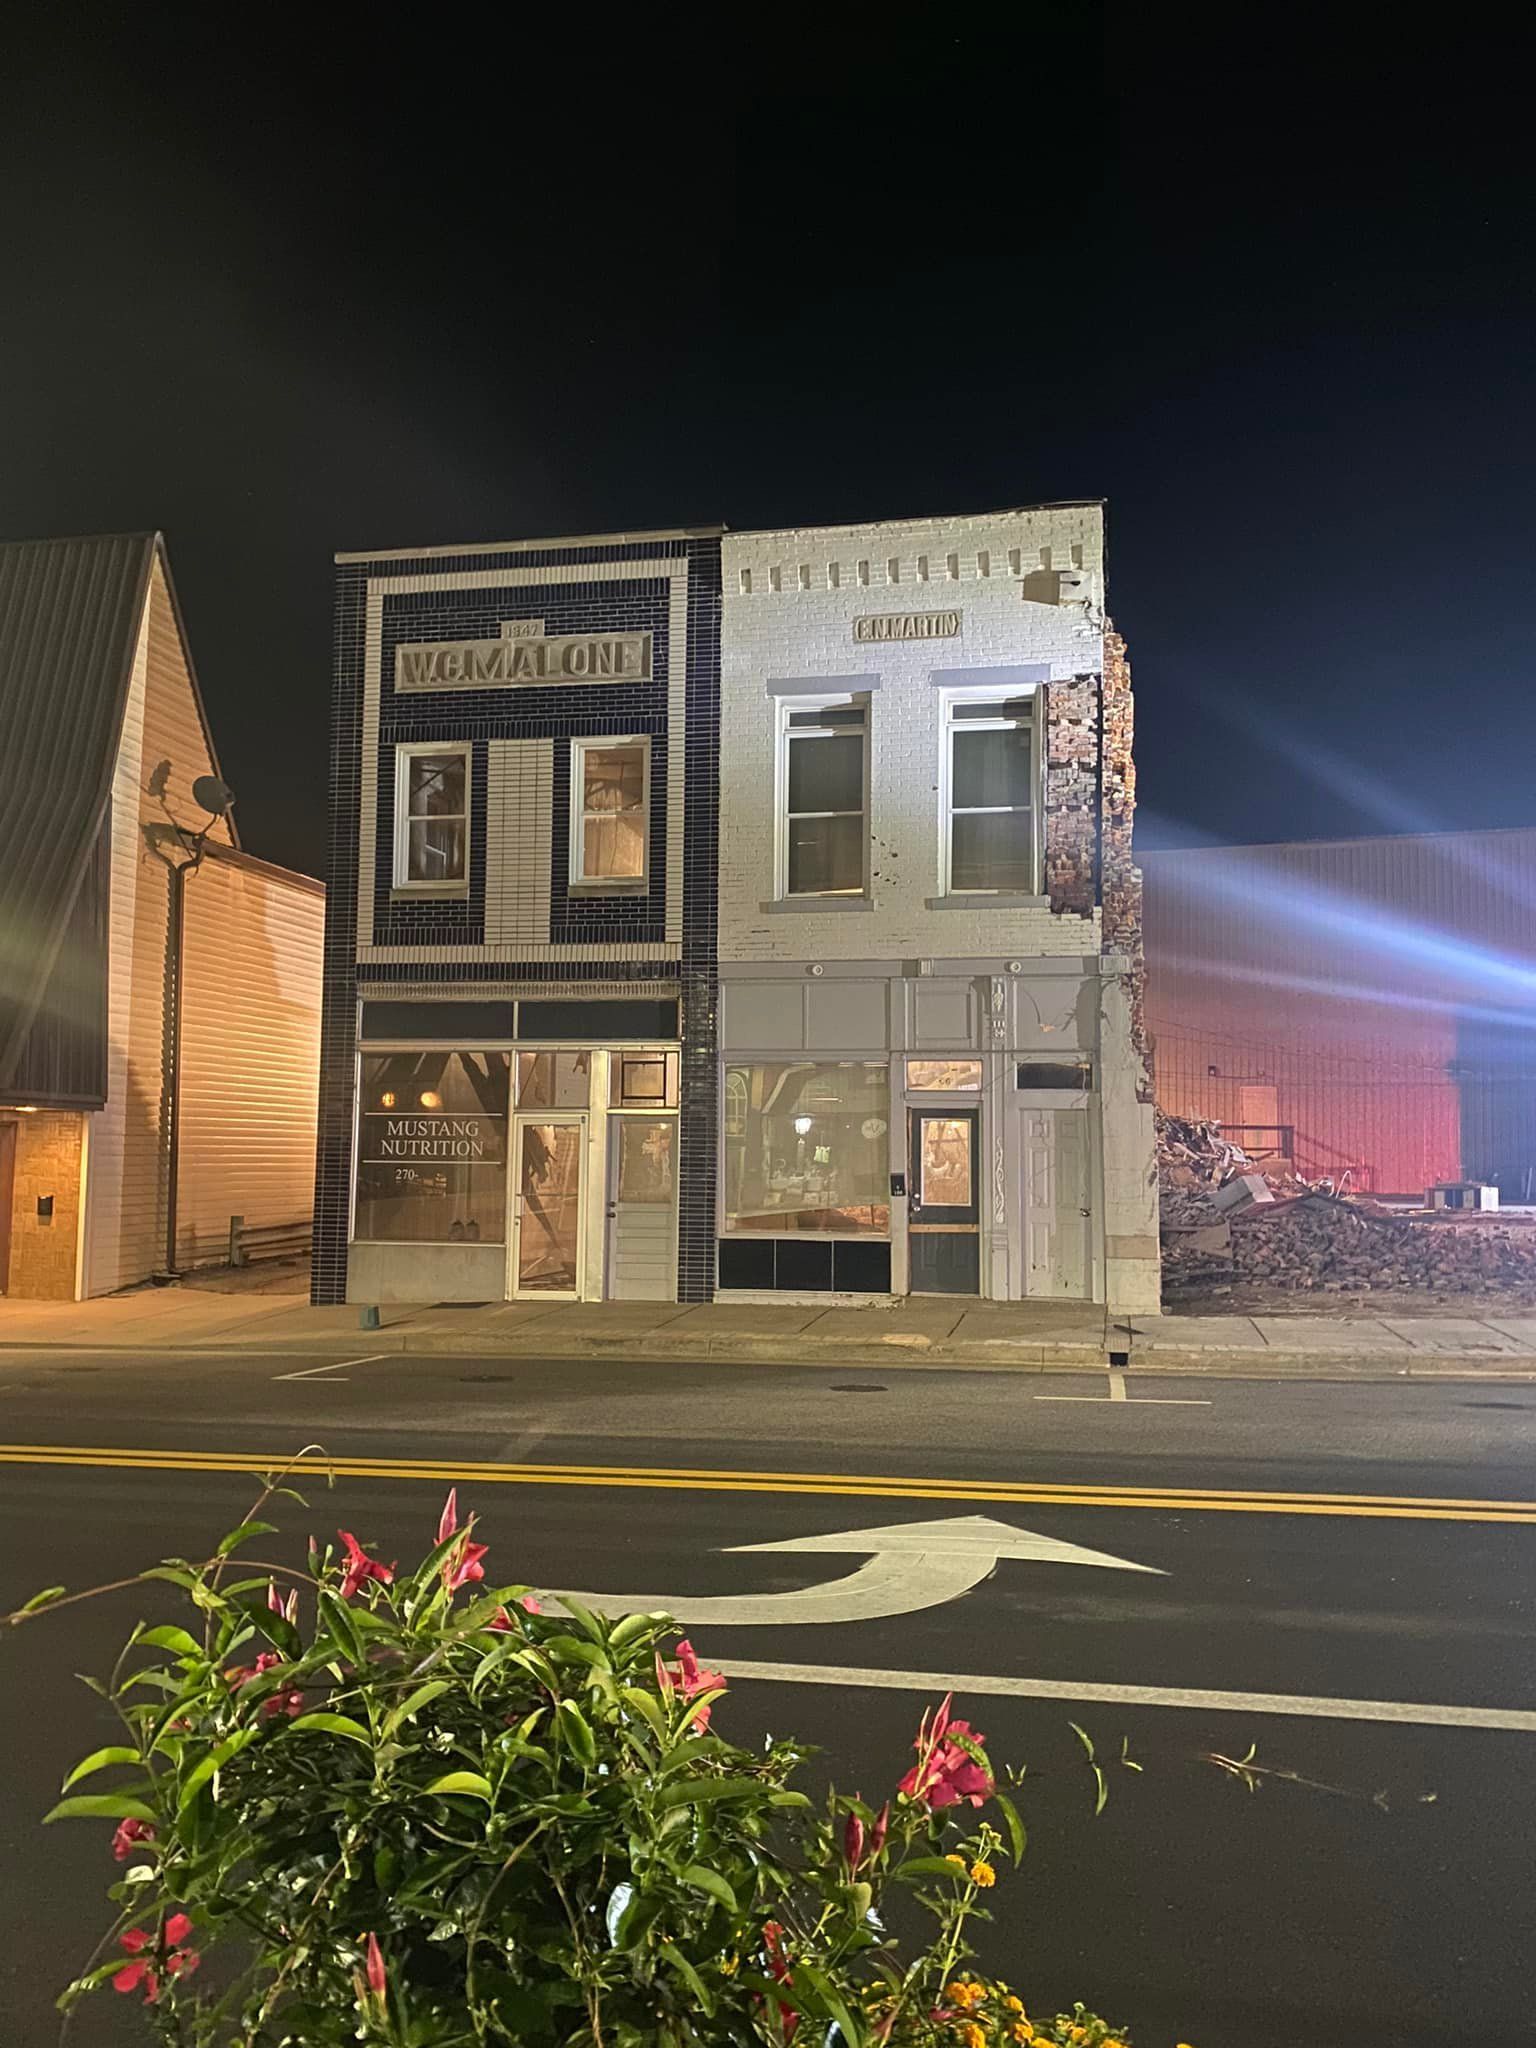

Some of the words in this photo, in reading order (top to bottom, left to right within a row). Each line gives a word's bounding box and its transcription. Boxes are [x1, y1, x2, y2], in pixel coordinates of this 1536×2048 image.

[387, 1120, 480, 1137] MUSTANG
[381, 1139, 484, 1156] NUTRITION
[395, 1168, 419, 1181] 270-
